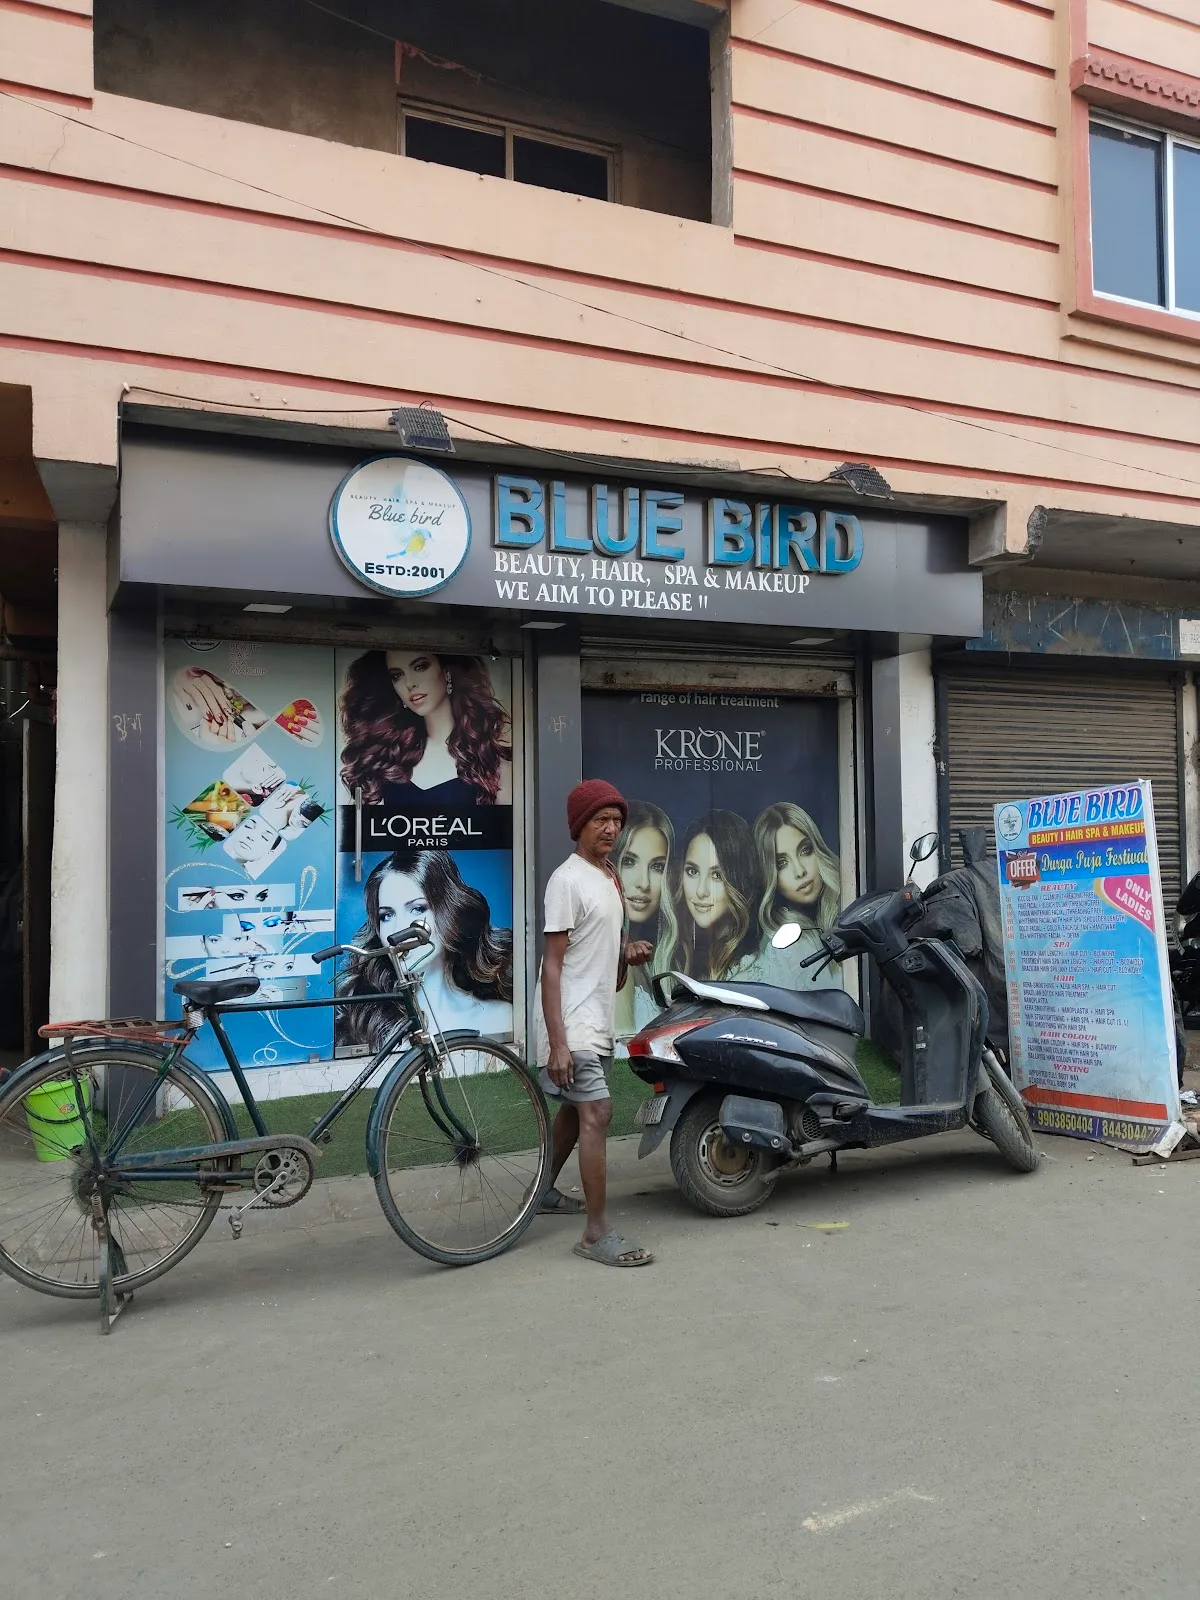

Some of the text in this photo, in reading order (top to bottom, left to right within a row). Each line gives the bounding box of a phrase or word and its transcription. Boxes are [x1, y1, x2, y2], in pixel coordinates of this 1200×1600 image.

[368, 504, 445, 526] Blue bird
[493, 473, 864, 576] BLUE BIRD
[364, 562, 445, 579] ESTD:2001
[494, 550, 811, 595] BEAUTY, HAIR, SPA & MAKEUP
[494, 580, 530, 602] WE
[535, 582, 579, 605] AIM
[585, 586, 613, 608] TO
[620, 588, 693, 612] PLEASE
[229, 667, 267, 675] MAKEUP
[640, 692, 779, 709] range of hair treatment
[655, 759, 762, 772] PROFESSIONAL
[1028, 787, 1144, 829] BLUE BIRD
[1032, 831, 1059, 844] BEAUTY
[1066, 829, 1083, 840] HAIR
[1086, 827, 1101, 838] SPA
[1103, 826, 1109, 837] &
[1010, 859, 1037, 878] OFFER
[1041, 845, 1149, 874] Durga Puja Festival
[1040, 883, 1076, 892] BEAUTY
[1125, 878, 1152, 903] ONLY
[1116, 888, 1152, 921] LADIES
[1081, 1016, 1090, 1024] SPA
[1062, 1032, 1097, 1041] COLOUR
[1053, 1063, 1089, 1073] WAXING
[1093, 1059, 1102, 1067] SPA
[1070, 1074, 1079, 1082] WAX
[1038, 1110, 1093, 1134] 9903850404
